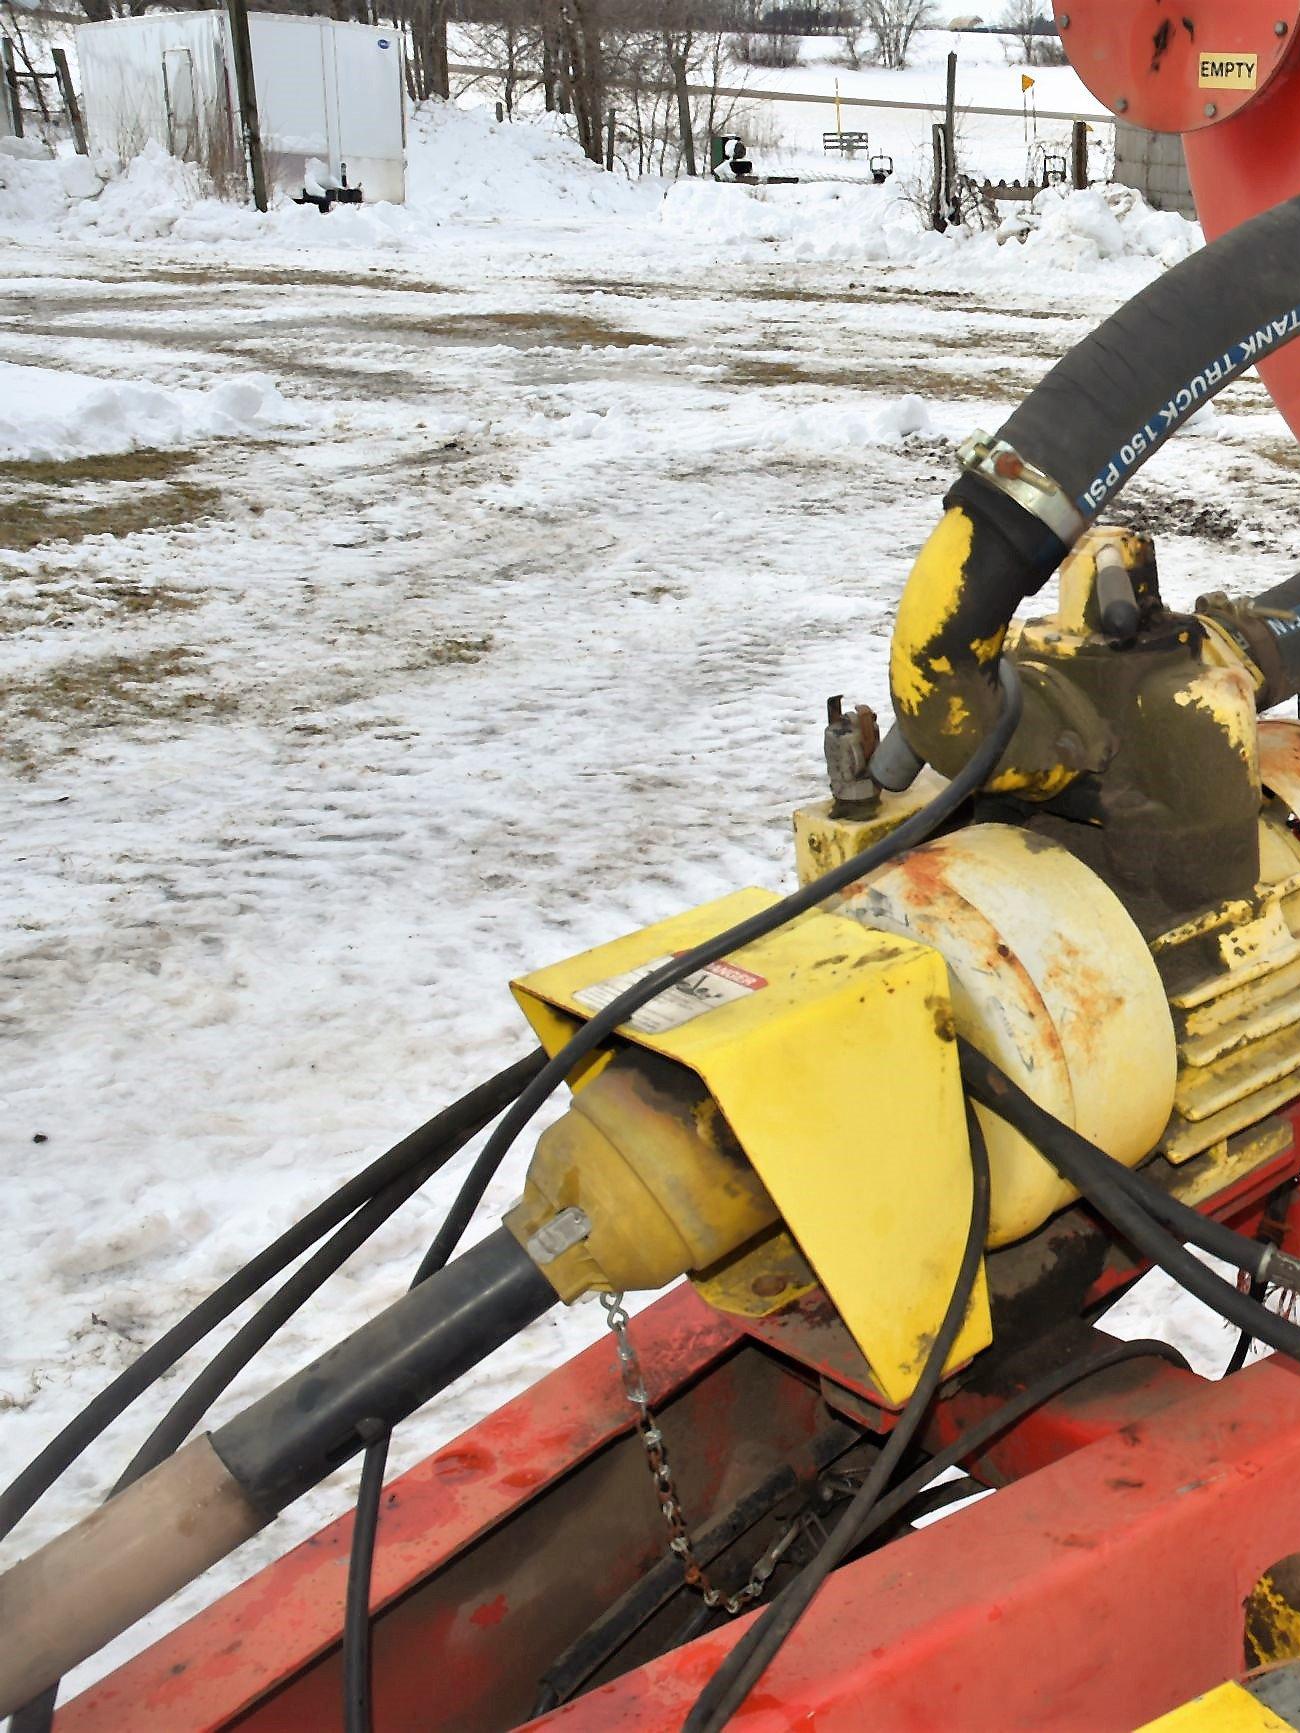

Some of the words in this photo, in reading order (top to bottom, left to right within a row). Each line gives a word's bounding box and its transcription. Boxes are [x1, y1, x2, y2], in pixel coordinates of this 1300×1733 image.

[1201, 61, 1254, 78] EMPTY
[1240, 310, 1300, 361] TANK
[1159, 353, 1237, 427] TRUCK
[1120, 424, 1158, 465] 150
[1083, 462, 1120, 509] PSI
